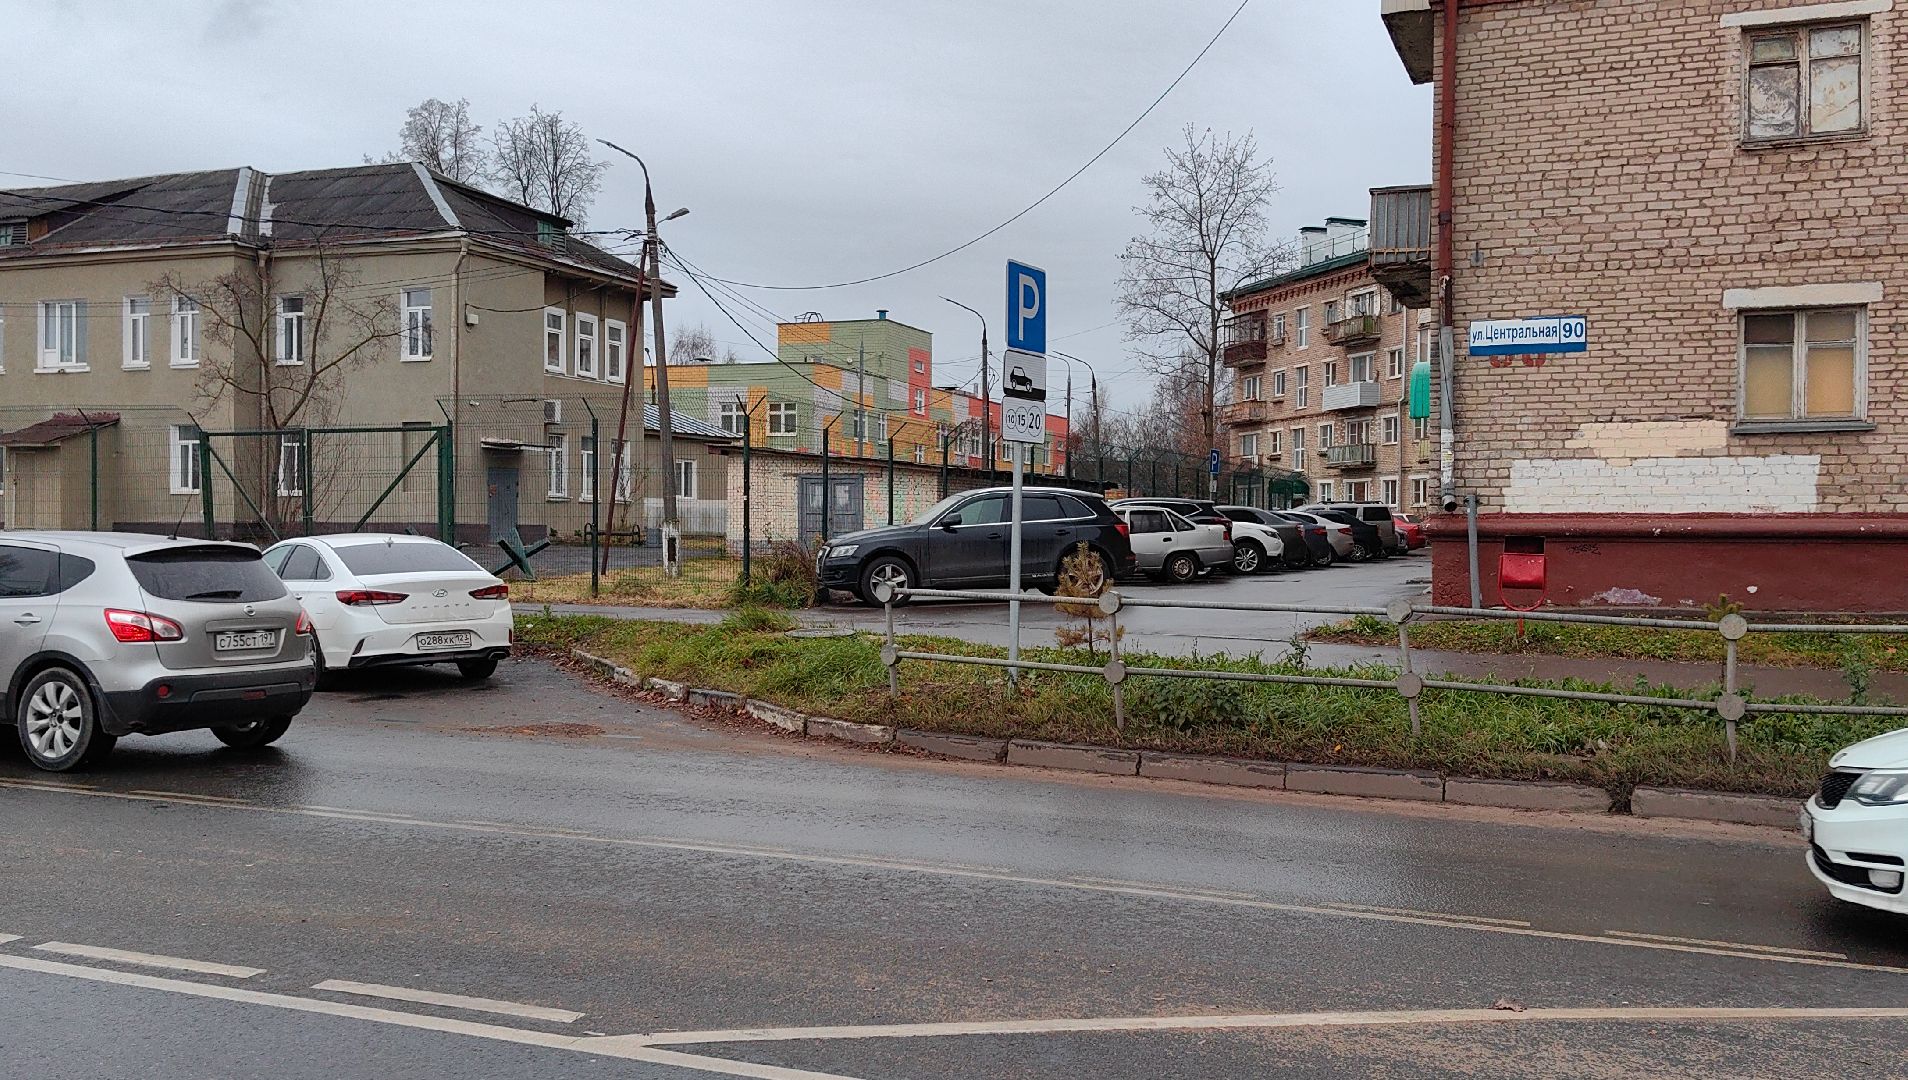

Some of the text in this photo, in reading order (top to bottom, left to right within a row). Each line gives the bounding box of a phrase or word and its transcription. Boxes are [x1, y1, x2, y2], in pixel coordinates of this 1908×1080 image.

[1018, 273, 1039, 341] P
[1562, 321, 1585, 339] 90
[1007, 412, 1041, 430] 10 15 20
[1211, 452, 1218, 471] P
